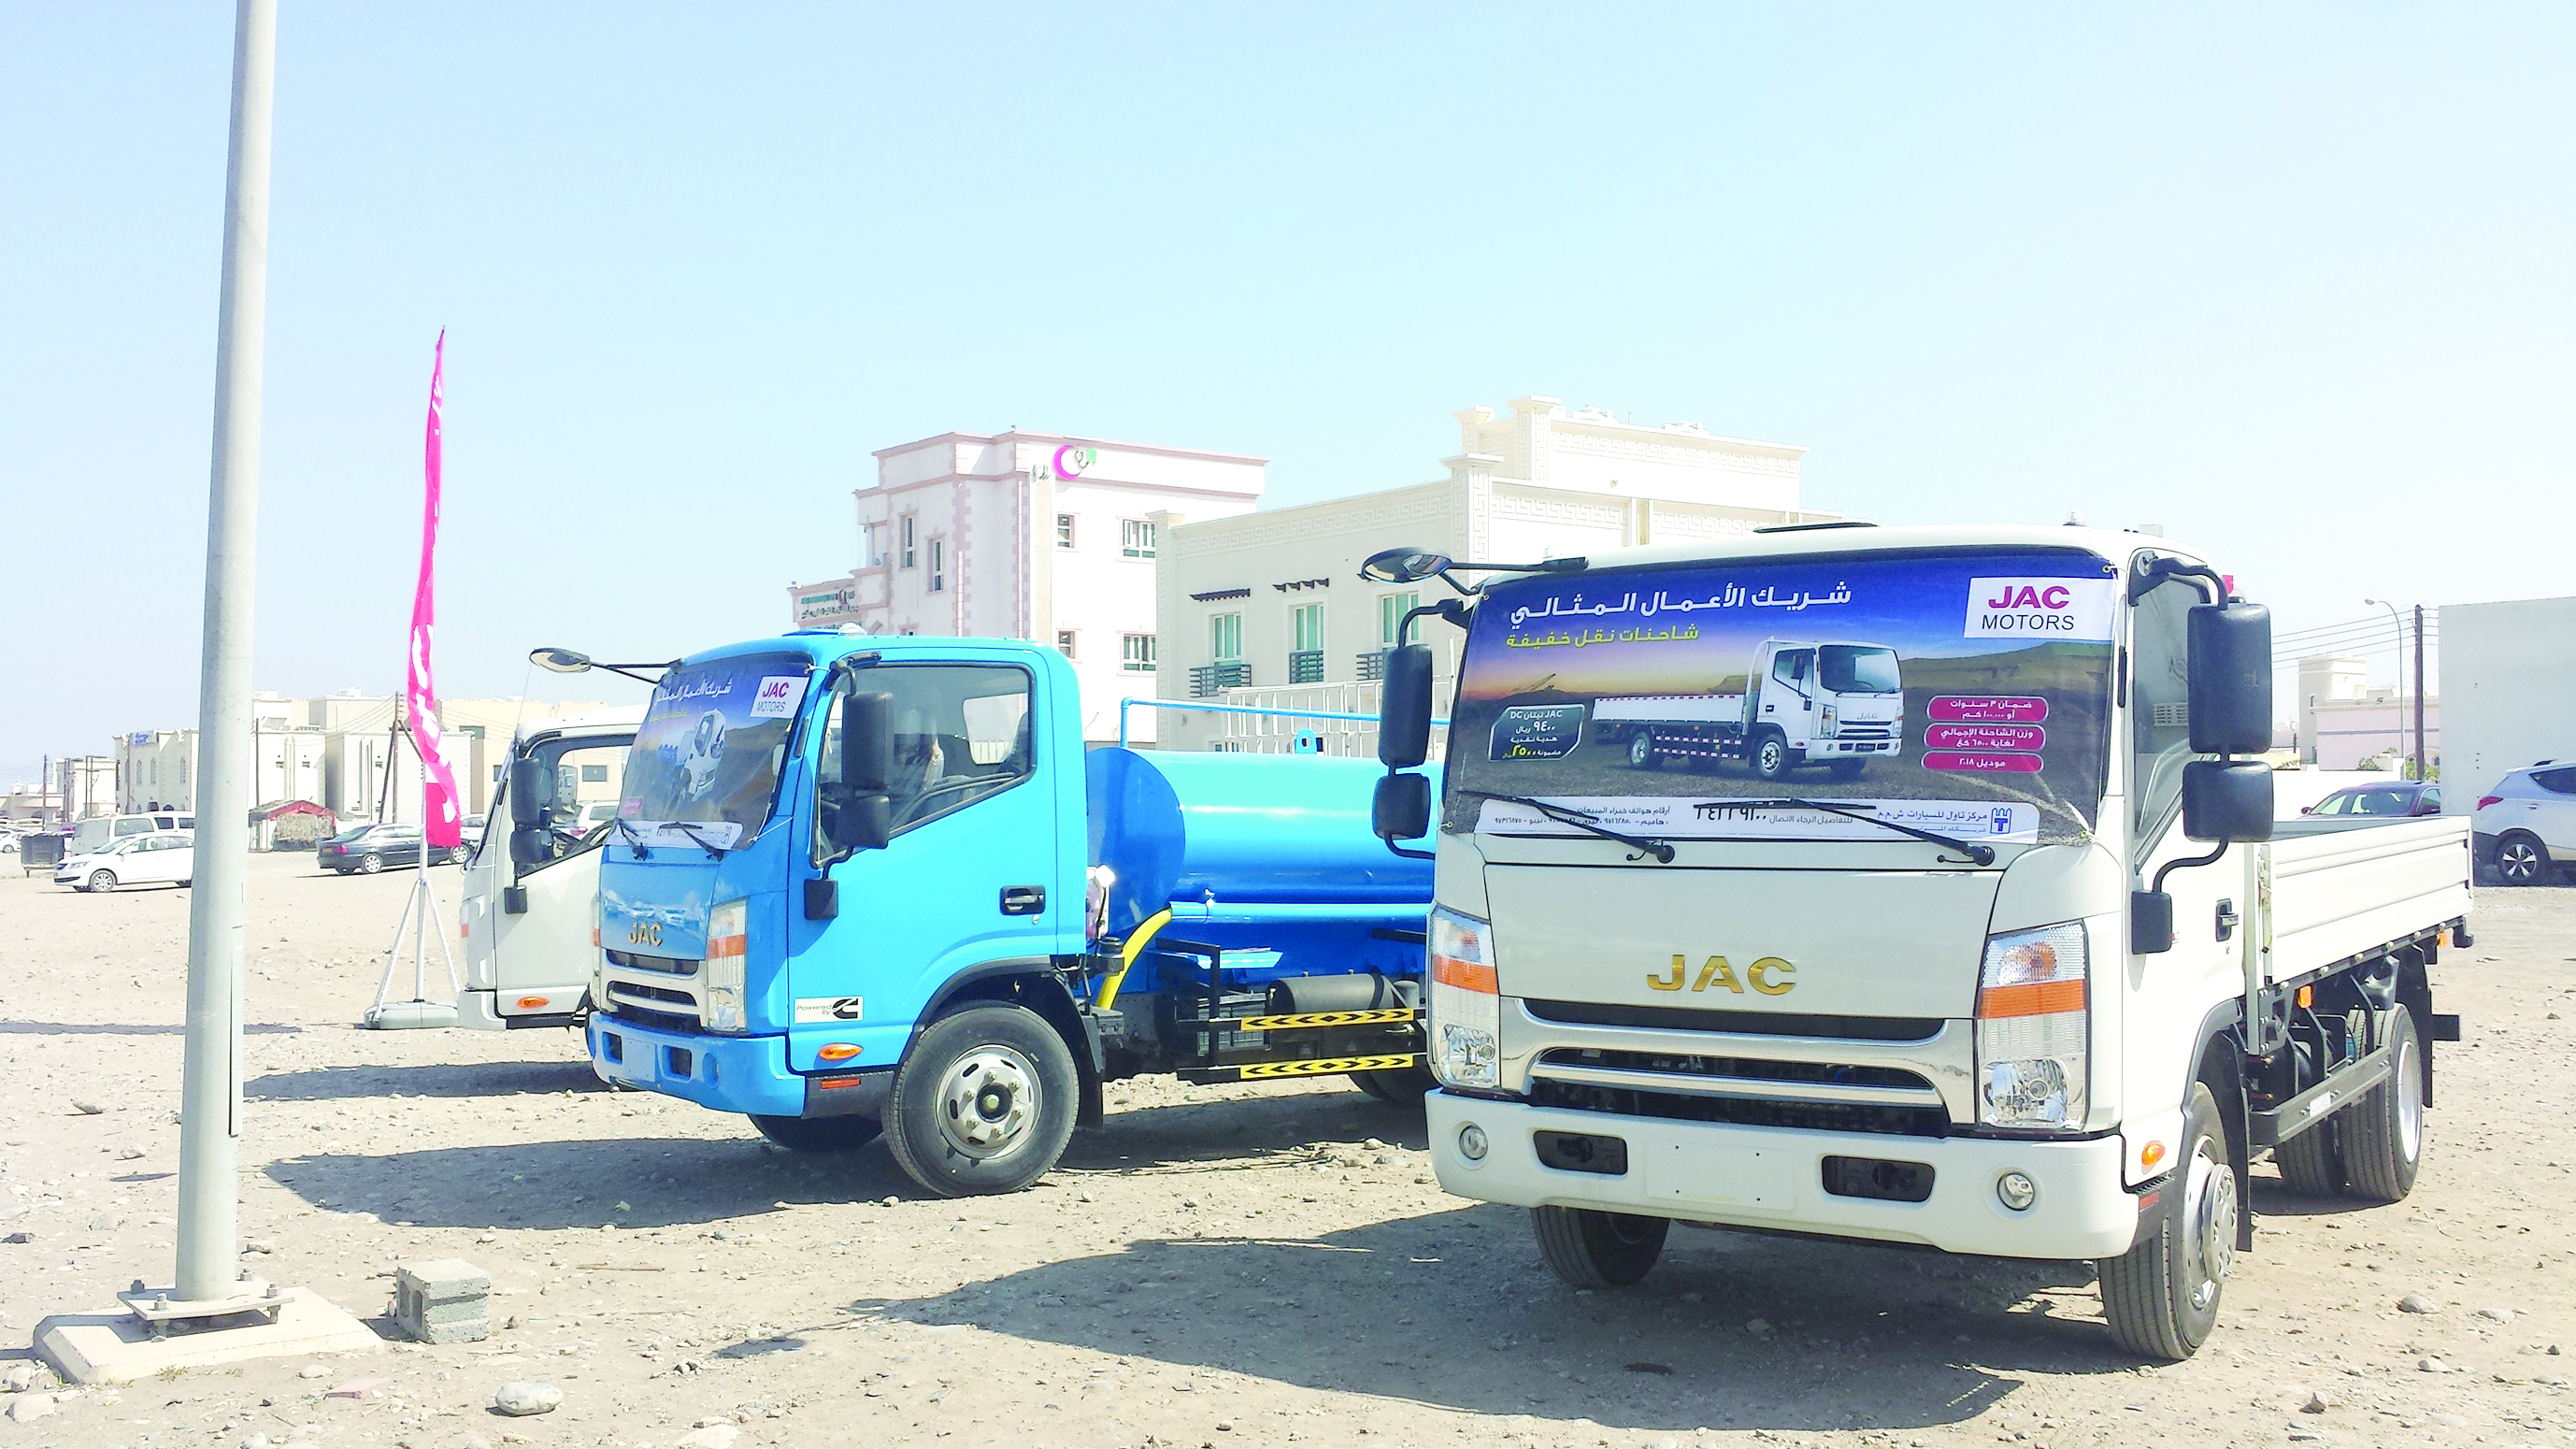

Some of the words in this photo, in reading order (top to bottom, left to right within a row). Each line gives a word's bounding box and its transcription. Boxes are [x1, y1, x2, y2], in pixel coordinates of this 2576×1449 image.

[1640, 582, 1746, 617] الأعمال
[1751, 581, 1852, 612] شريك
[1988, 585, 2070, 610] JAC
[1510, 592, 1638, 630] المثالي
[1982, 614, 2075, 631] MOTORS
[1574, 628, 1615, 648] نقل
[1619, 623, 1700, 642] شاحنات
[1506, 631, 1570, 651] خفيفة
[762, 681, 790, 698] JAC
[756, 701, 786, 712] MOTORS
[1950, 699, 1988, 709] سنوات
[1997, 700, 2032, 710] ضمان
[1510, 710, 1523, 719] DC
[1545, 710, 1563, 719] JAC
[1962, 710, 1982, 719] كم
[2007, 709, 2015, 720] أو
[1533, 721, 1555, 732] ٩٤٠٠
[1979, 727, 2015, 737] الشاحنة
[1940, 728, 1977, 739] الإجمالي
[2016, 729, 2034, 739] وزن
[1990, 739, 2015, 748] لغاية
[1976, 758, 2006, 768] موديل
[1908, 811, 1944, 821] للسيارات
[1946, 811, 1965, 822] تاول
[1966, 811, 1987, 822] مركز
[628, 920, 663, 947] JAC
[1646, 954, 1796, 996] JAC
